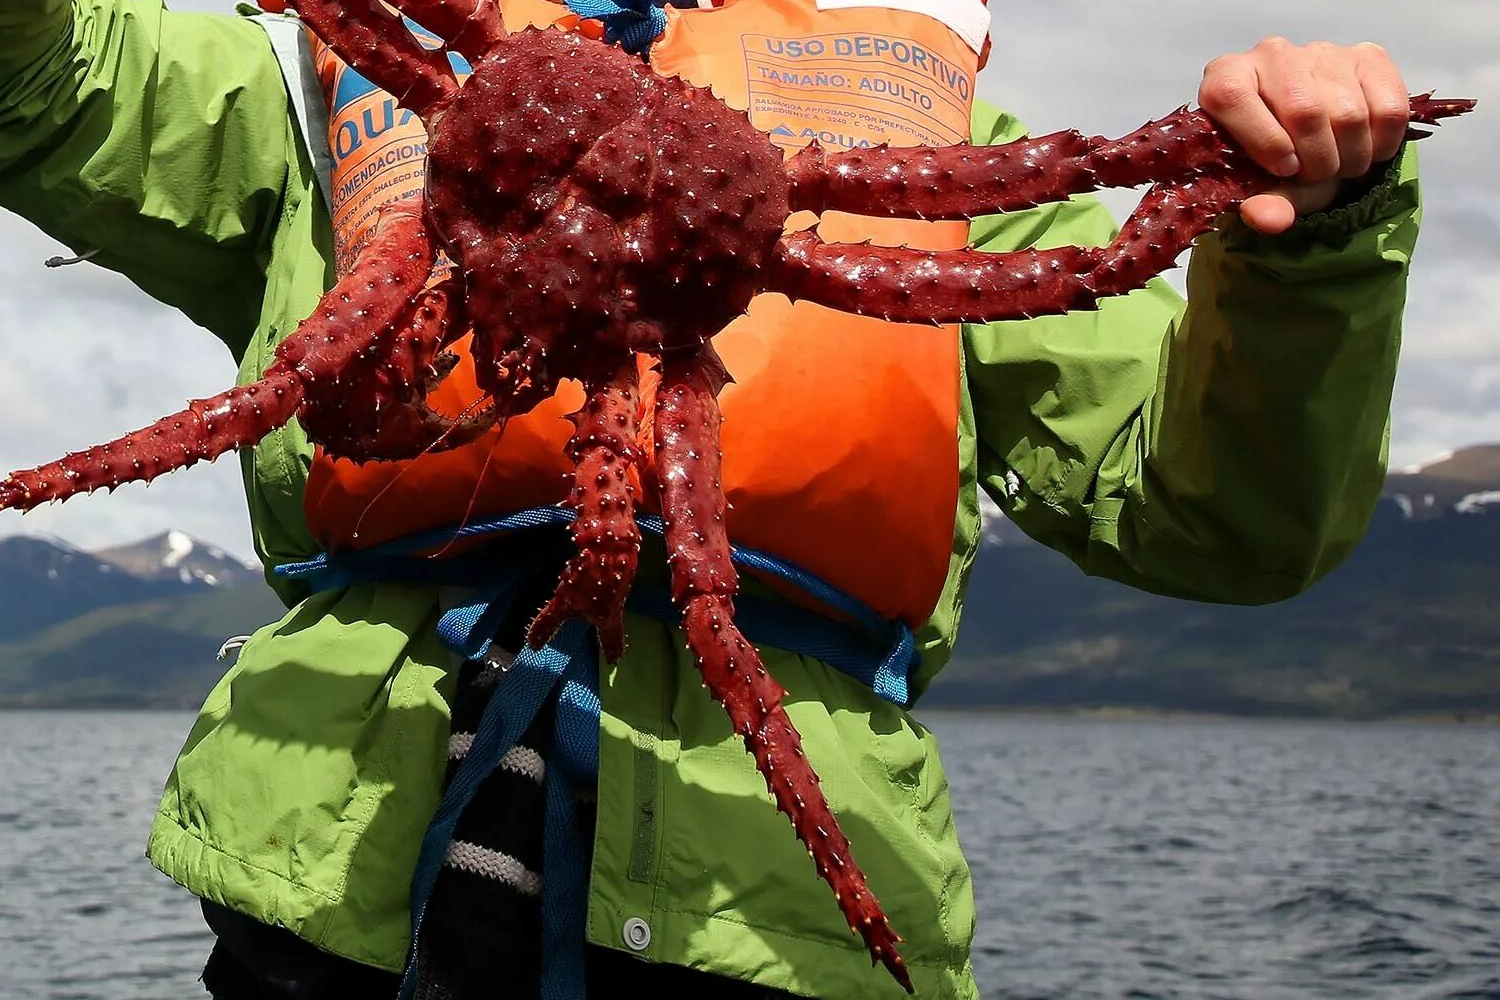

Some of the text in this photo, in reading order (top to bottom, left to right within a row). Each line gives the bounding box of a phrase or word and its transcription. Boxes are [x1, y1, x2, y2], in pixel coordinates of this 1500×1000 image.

[766, 36, 968, 101] USO DEPORTIVO
[757, 66, 932, 110] TAMAÑO: ADULTO
[755, 105, 810, 119] EXPEDIENTE
[805, 106, 857, 118] APROBADO
[859, 114, 878, 123] POR
[879, 118, 929, 142] PREFECTURA
[331, 99, 414, 170] QU
[799, 127, 881, 148] AQUA
[373, 173, 411, 195] CHALECO
